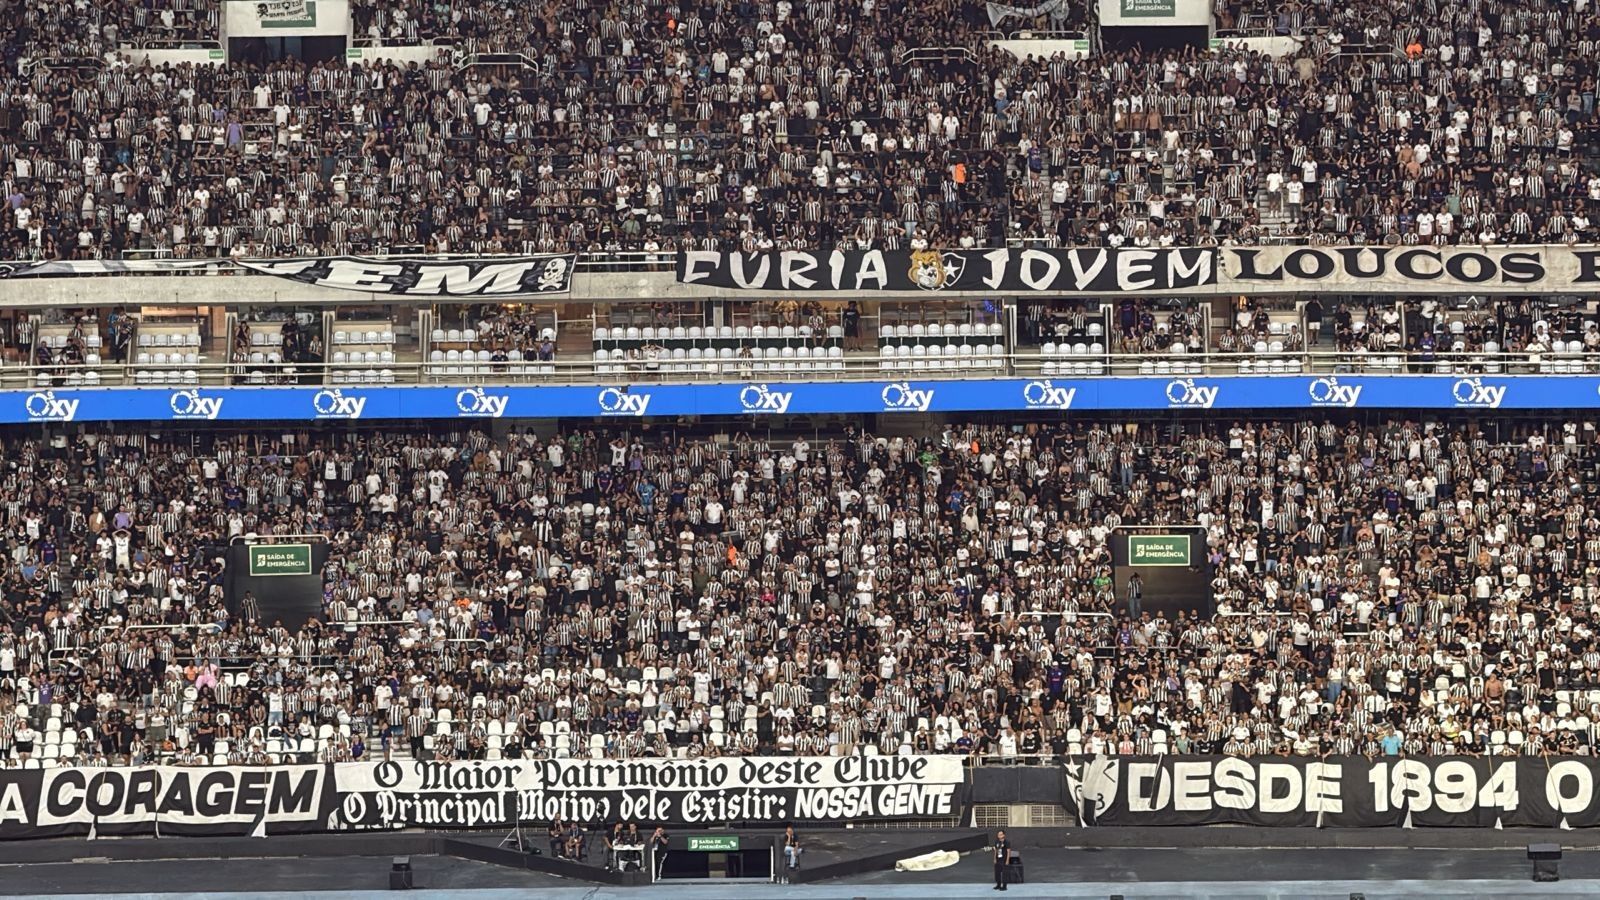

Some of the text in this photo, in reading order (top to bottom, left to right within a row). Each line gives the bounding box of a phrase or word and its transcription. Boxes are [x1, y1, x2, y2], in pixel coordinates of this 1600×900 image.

[683, 248, 1213, 291] FÚRIA JOVEM
[1230, 247, 1546, 284] LOUCOS
[26, 391, 79, 421] Oxy
[170, 389, 223, 419] Oxy
[313, 388, 366, 418] Oxy
[456, 387, 508, 417] Oxy
[598, 386, 650, 416] Oxy
[741, 384, 792, 414] Oxy
[882, 382, 934, 412] Oxy
[1024, 380, 1076, 410] Oxy
[1166, 379, 1219, 408] Oxy
[1309, 378, 1362, 408] Oxy
[1453, 377, 1506, 408] Oxy
[374, 755, 928, 791] O Maior Patrimônio deste Clube
[1128, 757, 1343, 812] DESDE
[1369, 759, 1519, 813] 1894
[0, 769, 318, 824] A CORAGEM
[343, 783, 955, 828] O Principal Motivo dele Existir: NOSSA GENTE
